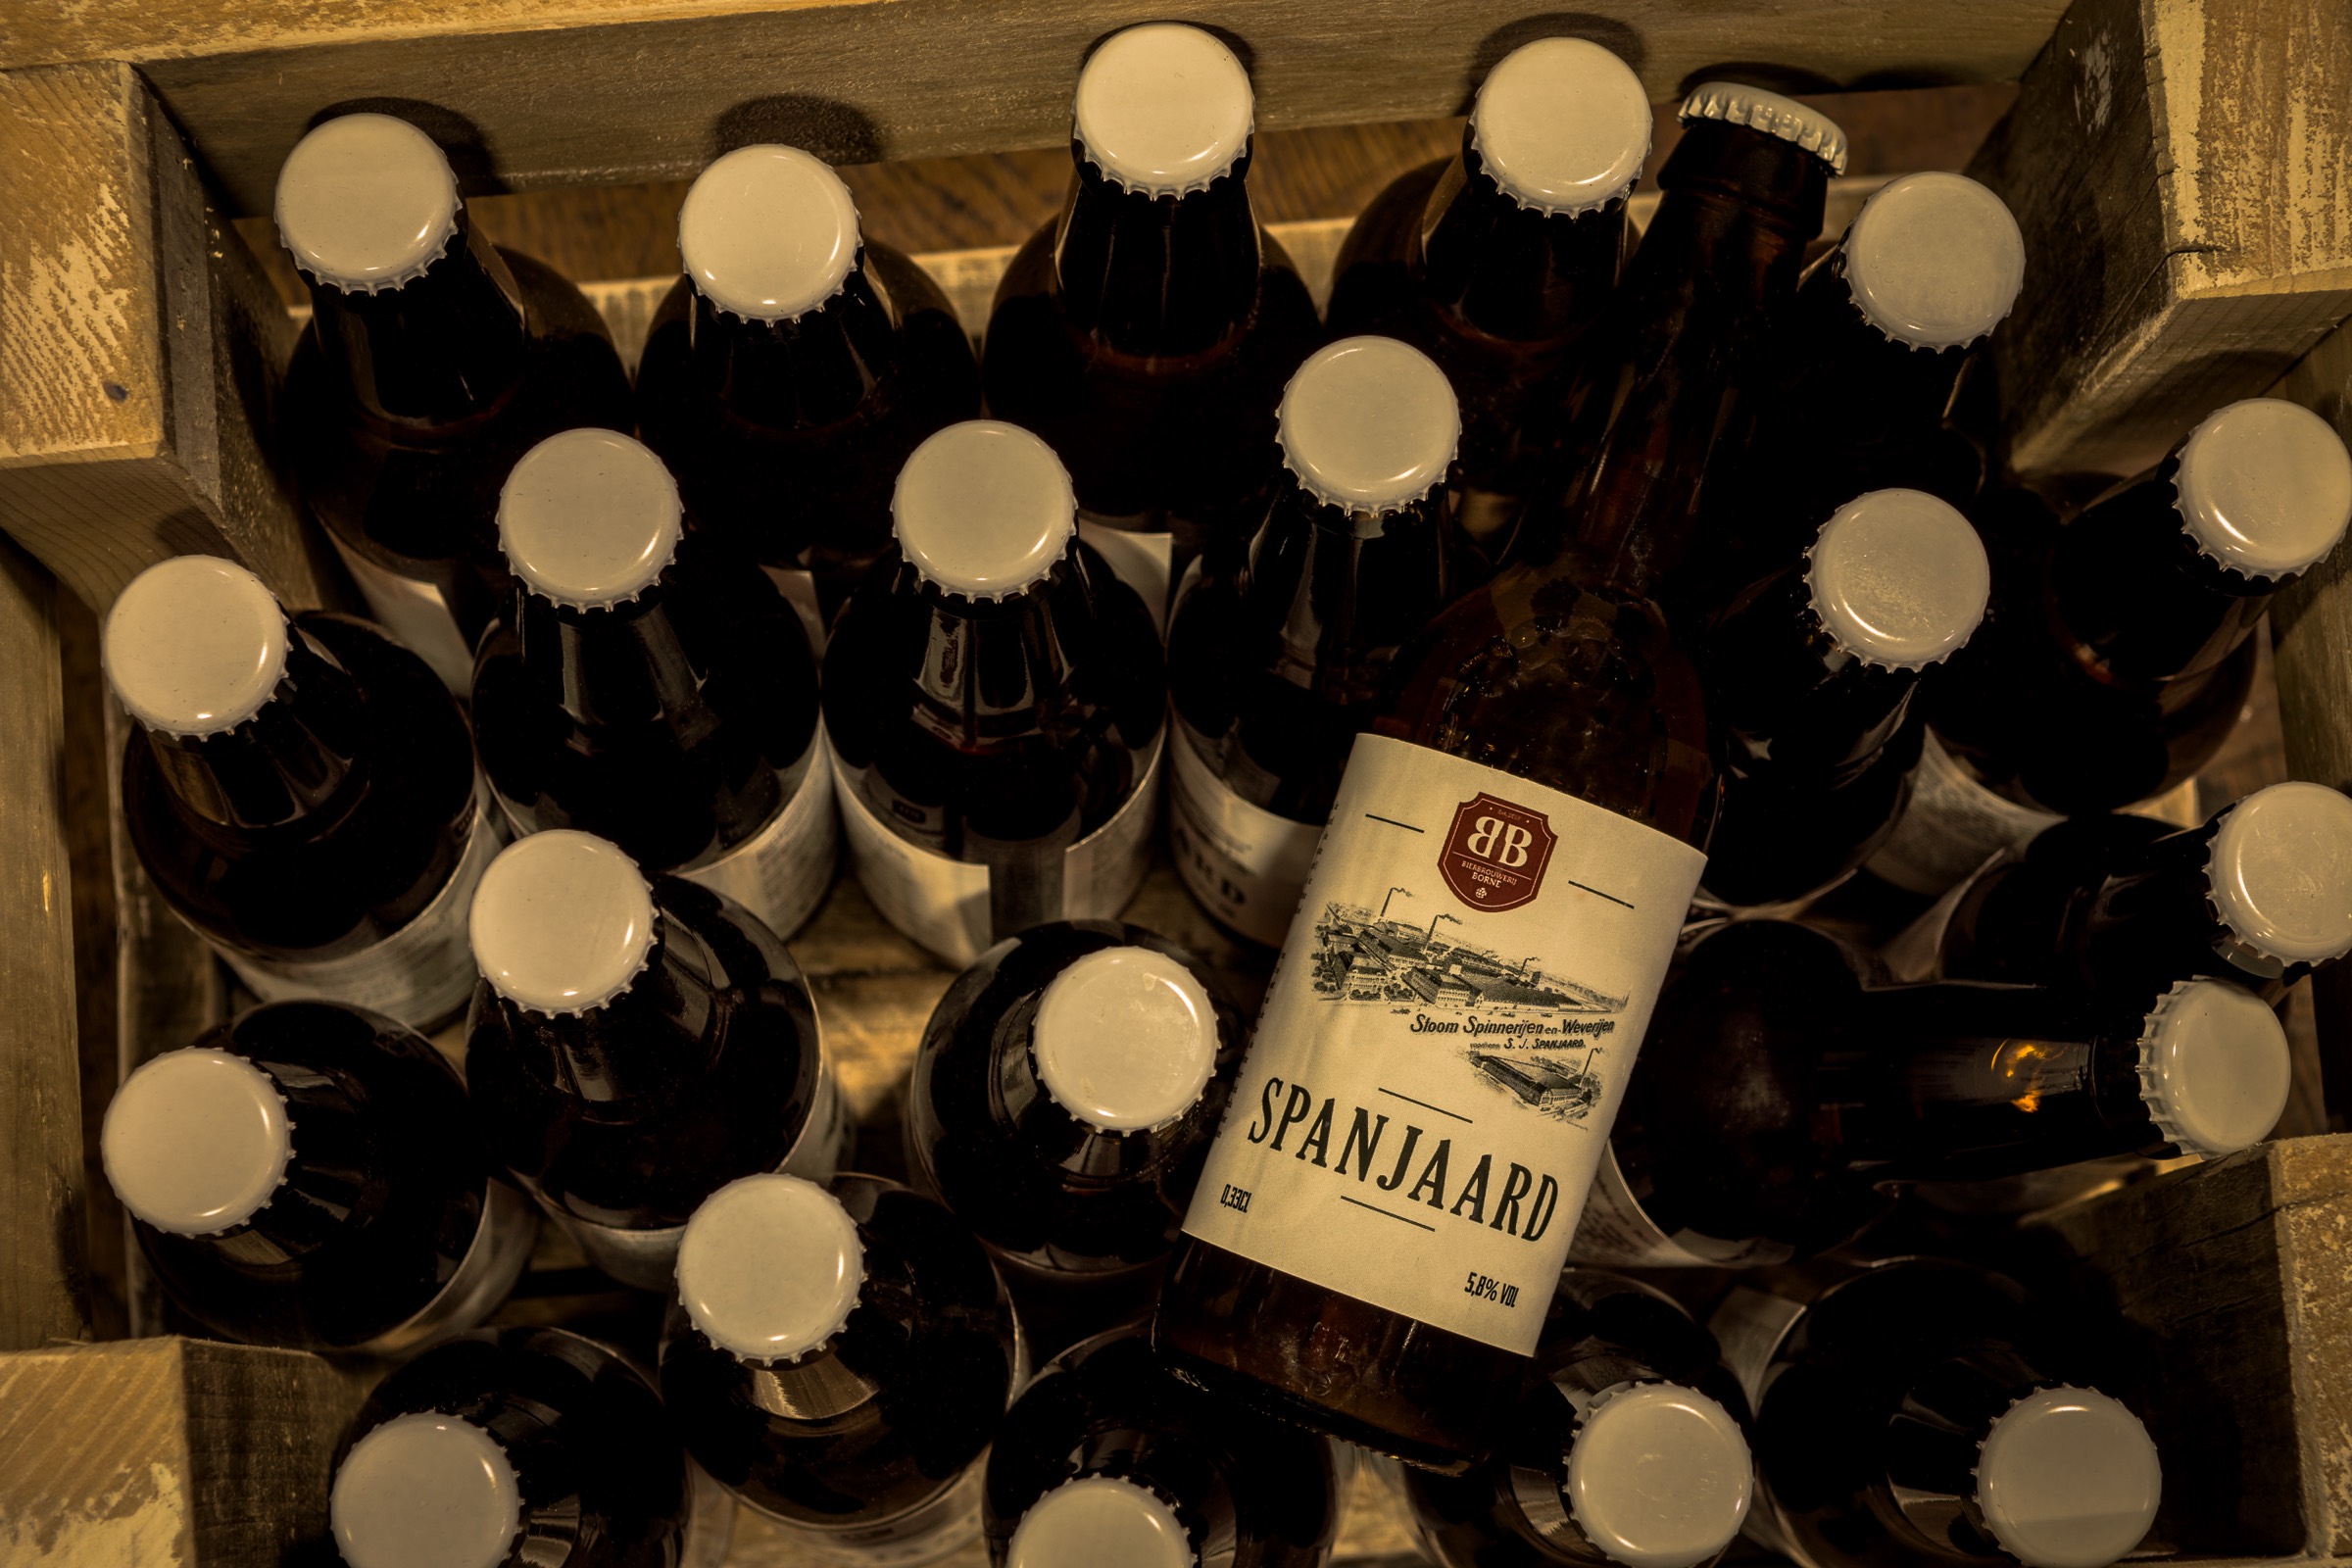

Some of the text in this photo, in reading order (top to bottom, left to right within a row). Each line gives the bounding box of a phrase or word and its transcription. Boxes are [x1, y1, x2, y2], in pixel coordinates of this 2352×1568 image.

[1461, 860, 1517, 885] BIERBROUWERIJ
[1472, 872, 1502, 888] BORNE
[1463, 1015, 1544, 1038] Spinnerijen
[1561, 1018, 1615, 1038] Weverijen
[1503, 1038, 1515, 1049] S.
[1248, 1077, 1559, 1242] SPANJAARD
[1220, 1184, 1252, 1213] 0,33CL
[1464, 1272, 1520, 1307] 5,8% VOL
